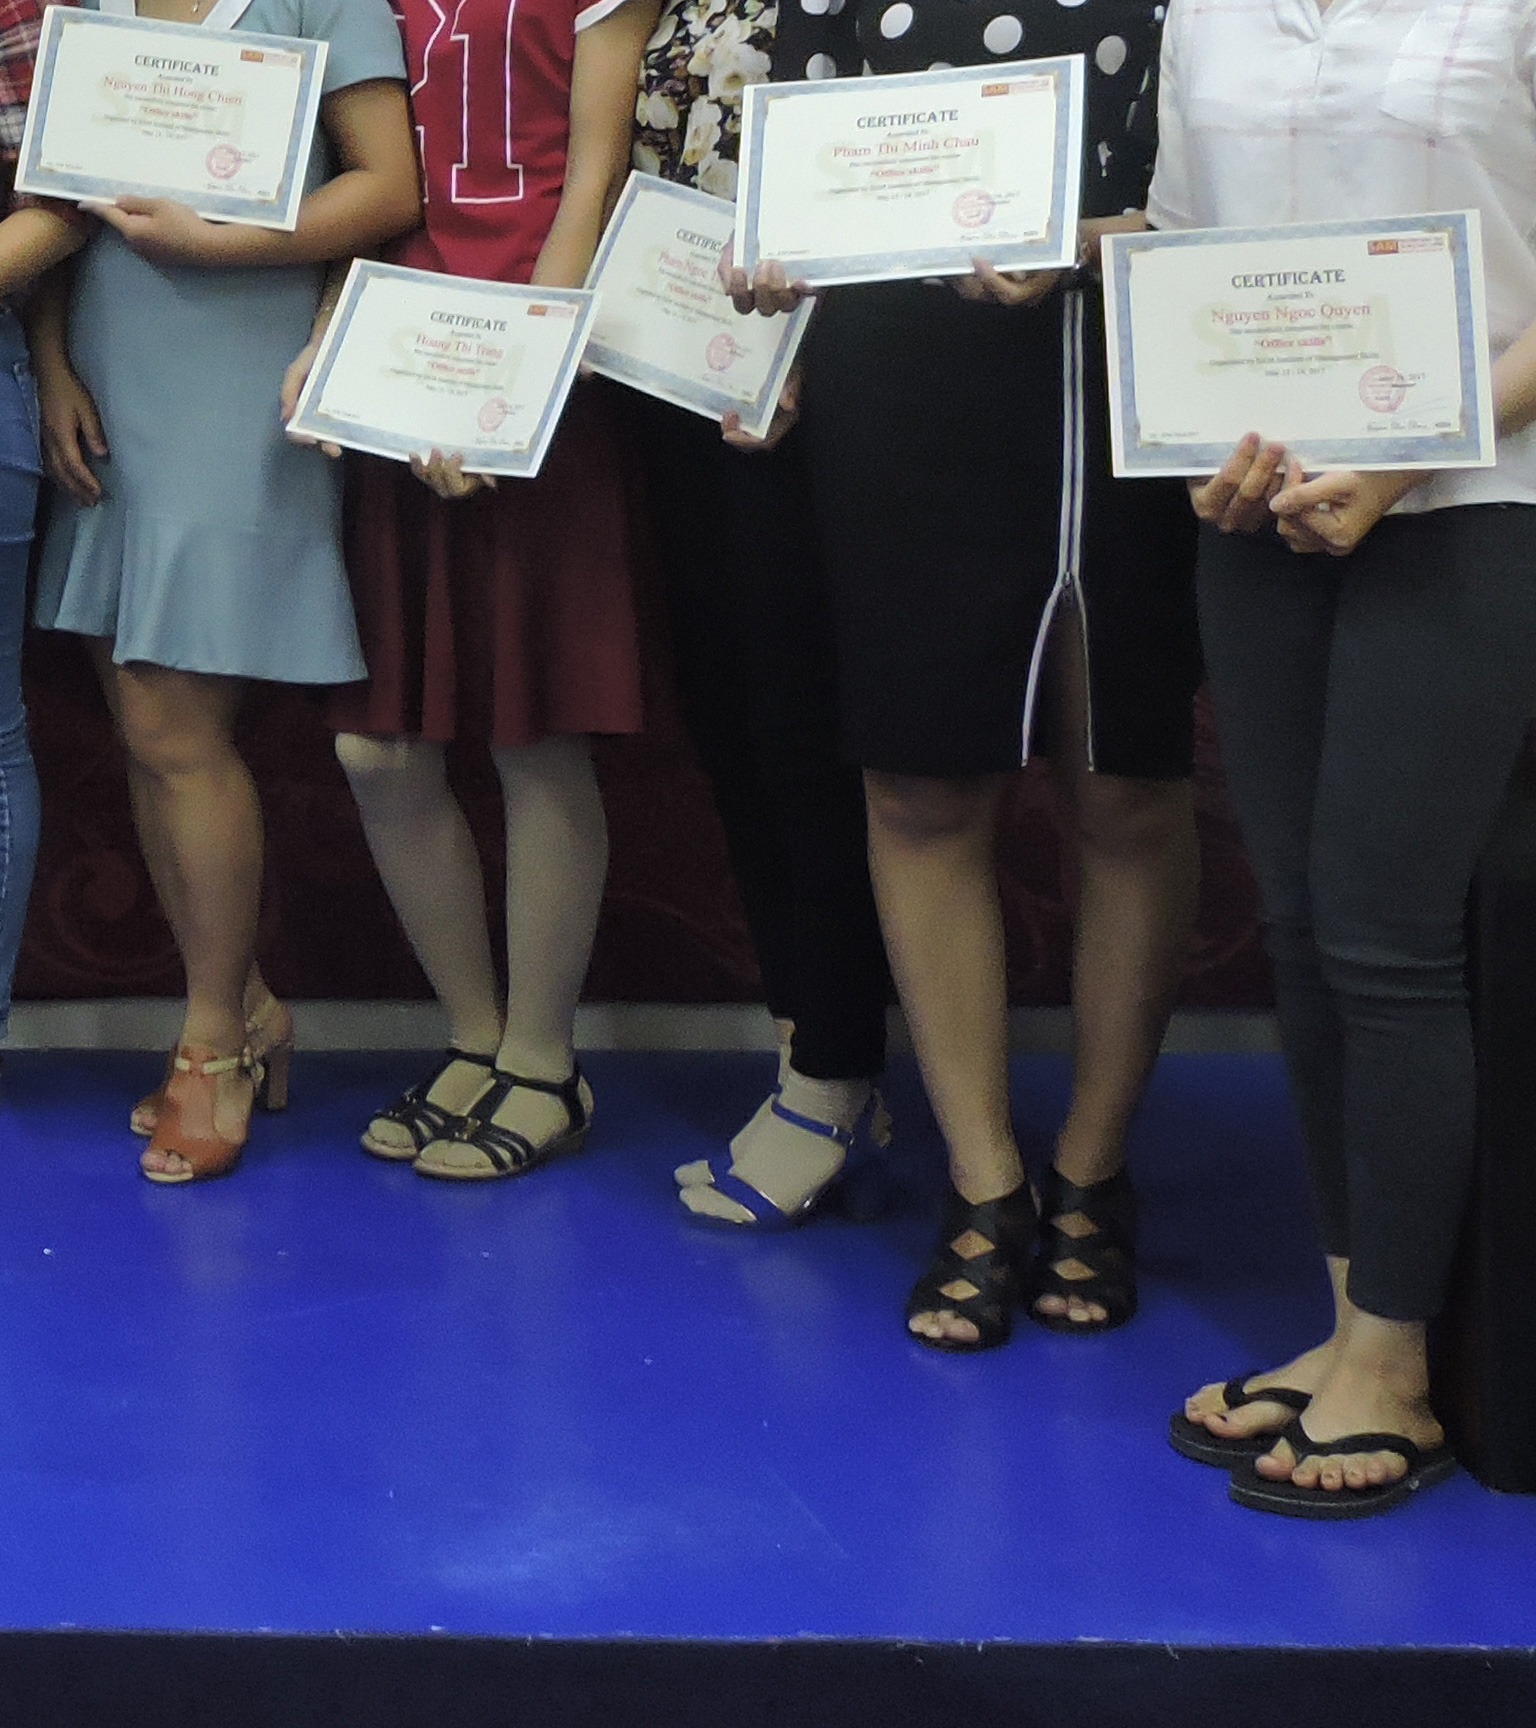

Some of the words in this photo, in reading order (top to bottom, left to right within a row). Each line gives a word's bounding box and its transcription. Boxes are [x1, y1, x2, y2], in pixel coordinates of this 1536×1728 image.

[135, 55, 220, 77] CERTIFICATE
[857, 110, 959, 129] CERTIFICATE
[878, 143, 899, 155] Thi
[676, 228, 724, 253] CERTIFIC
[1231, 269, 1346, 288] CERTIFICATE
[431, 311, 508, 332] CERTIFICATE
[1212, 309, 1271, 325] Nguyen
[1275, 306, 1316, 322] Ngoc
[1320, 302, 1371, 320] Quyen
